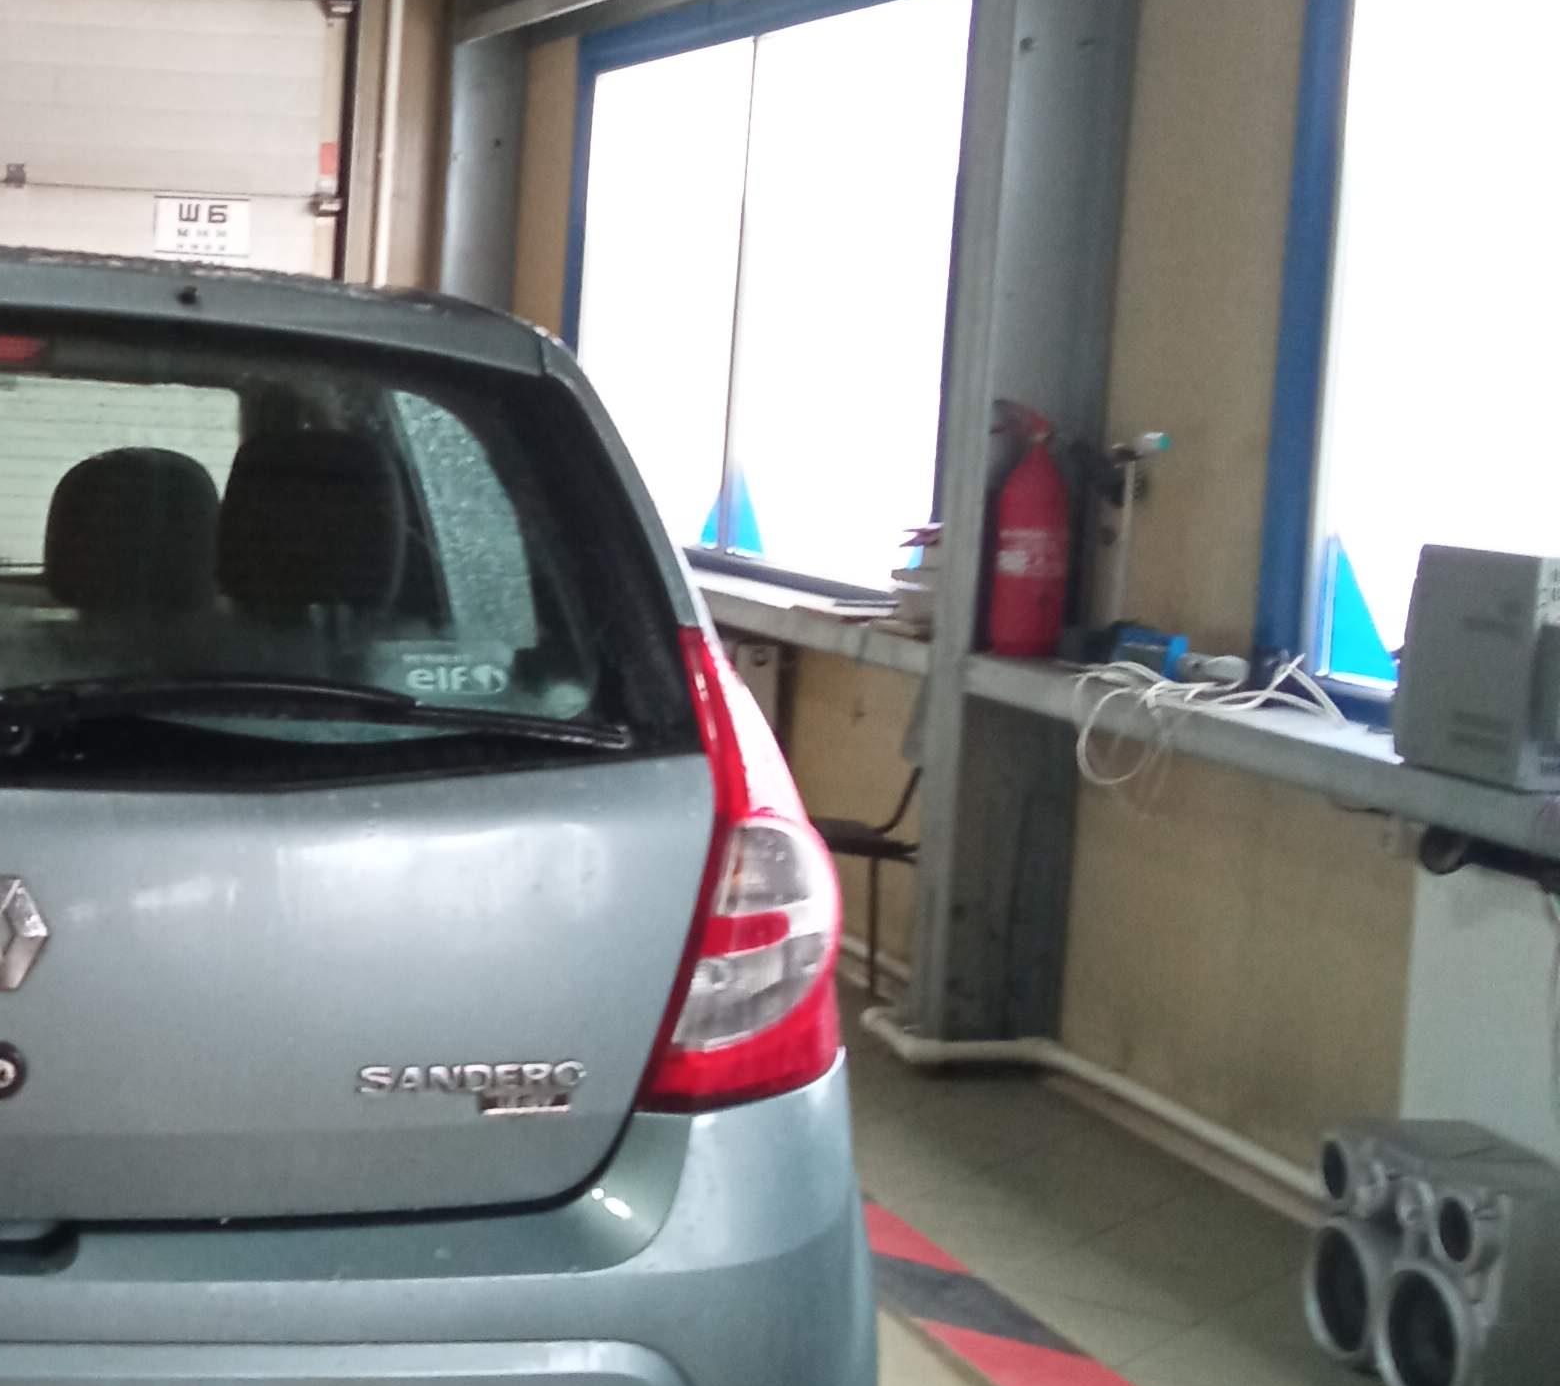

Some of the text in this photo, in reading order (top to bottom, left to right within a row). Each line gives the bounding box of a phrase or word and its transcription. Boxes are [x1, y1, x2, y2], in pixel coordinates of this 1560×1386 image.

[178, 202, 229, 224] Ш Б
[405, 665, 469, 691] elf
[354, 1059, 588, 1093] SANDERO
